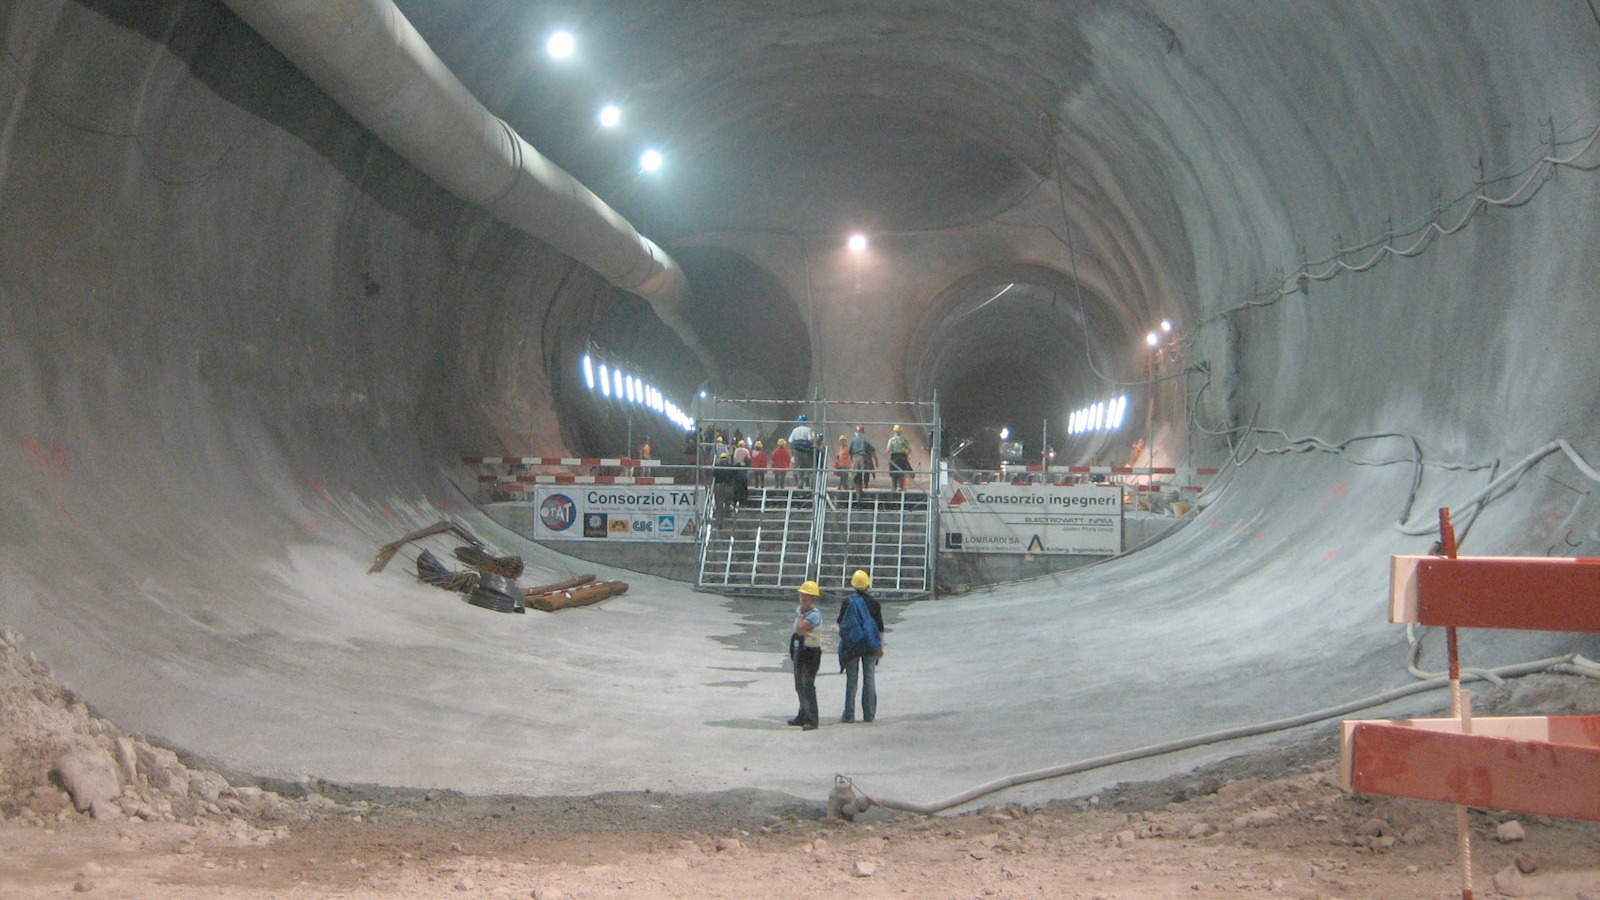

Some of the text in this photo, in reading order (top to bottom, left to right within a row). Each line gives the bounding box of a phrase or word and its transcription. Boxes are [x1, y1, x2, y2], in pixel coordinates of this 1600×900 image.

[587, 491, 699, 506] Consorzio TAT
[977, 493, 1116, 508] Consorzio ingegneri
[551, 502, 572, 523] TAT
